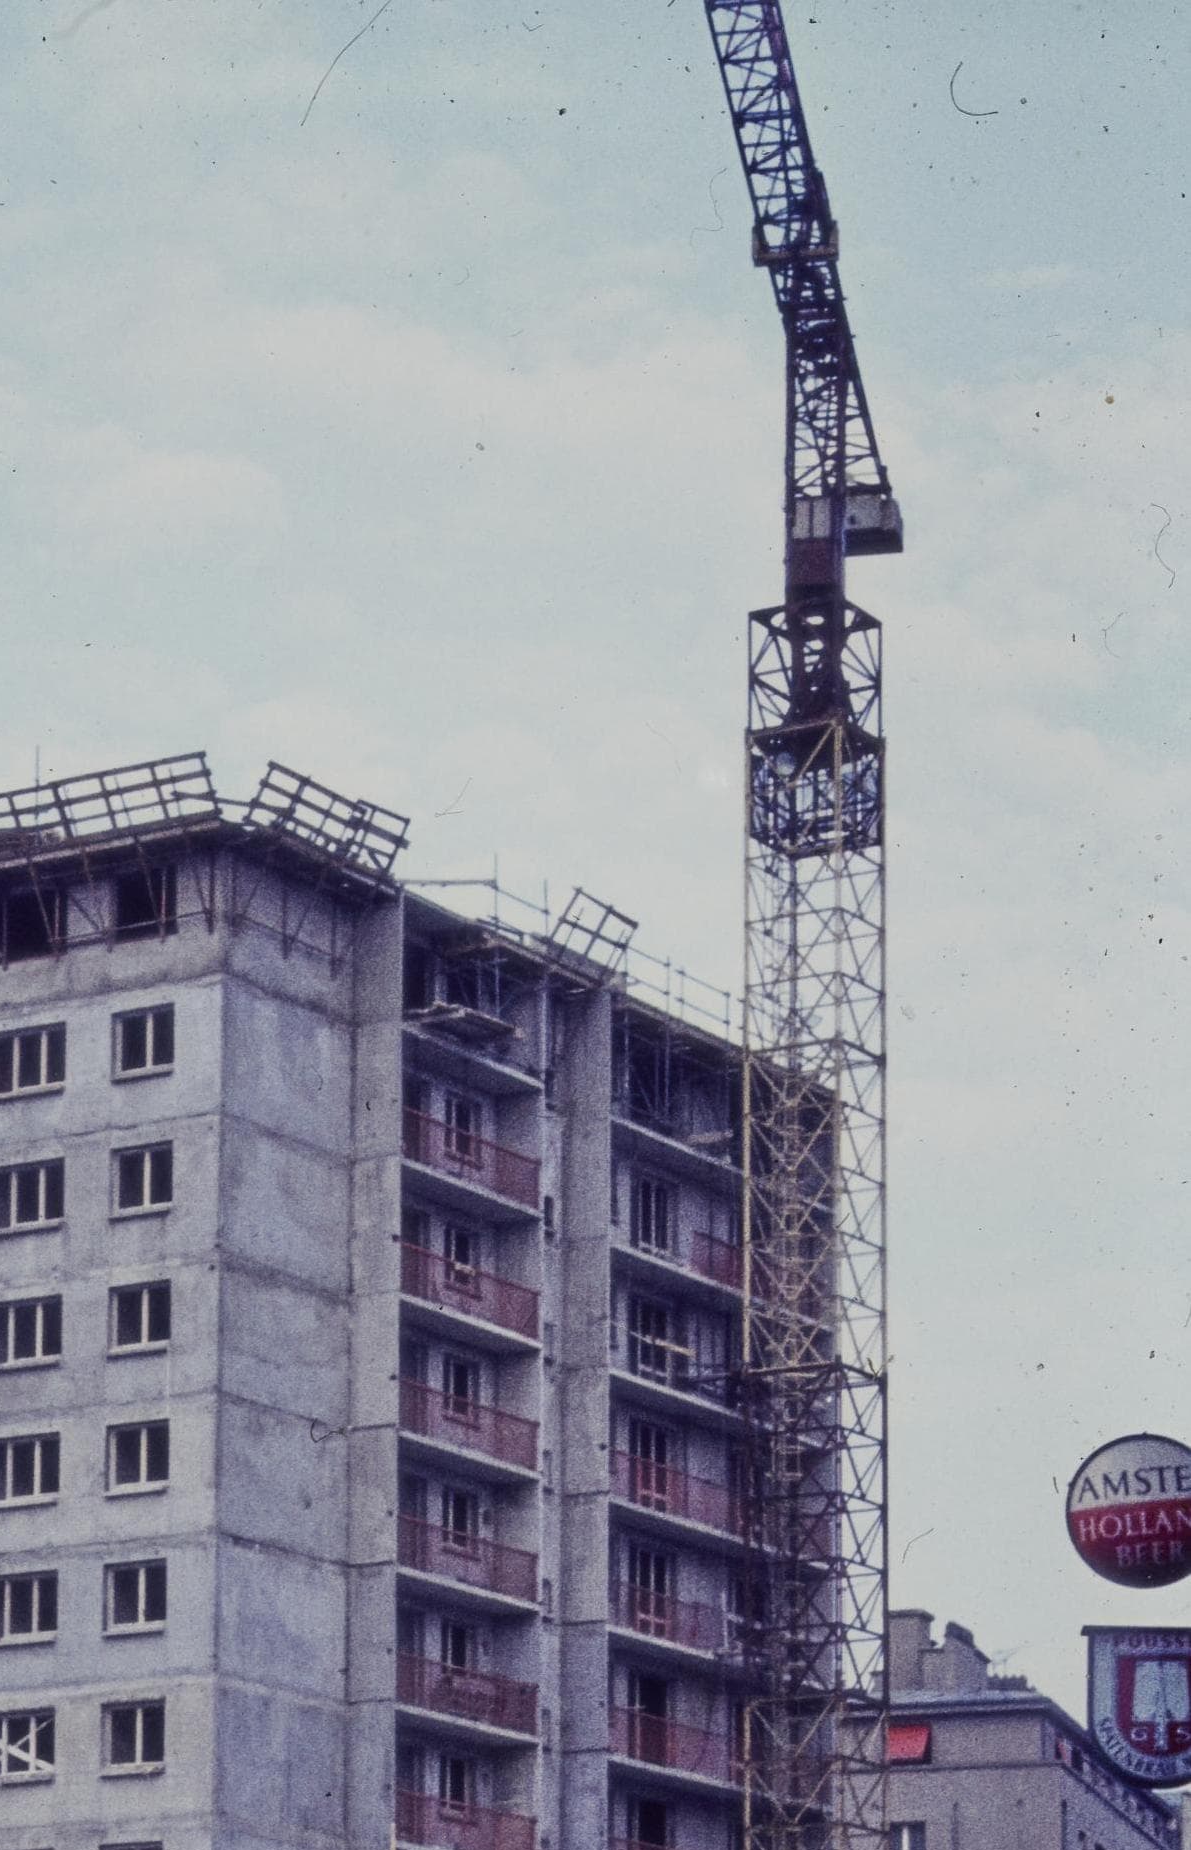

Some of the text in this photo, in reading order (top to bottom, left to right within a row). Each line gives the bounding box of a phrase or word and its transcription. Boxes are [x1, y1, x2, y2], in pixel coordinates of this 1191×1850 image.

[1077, 1465, 1191, 1503] AMSTE
[1116, 1541, 1184, 1567] BEER
[1113, 1632, 1191, 1649] POUSS
